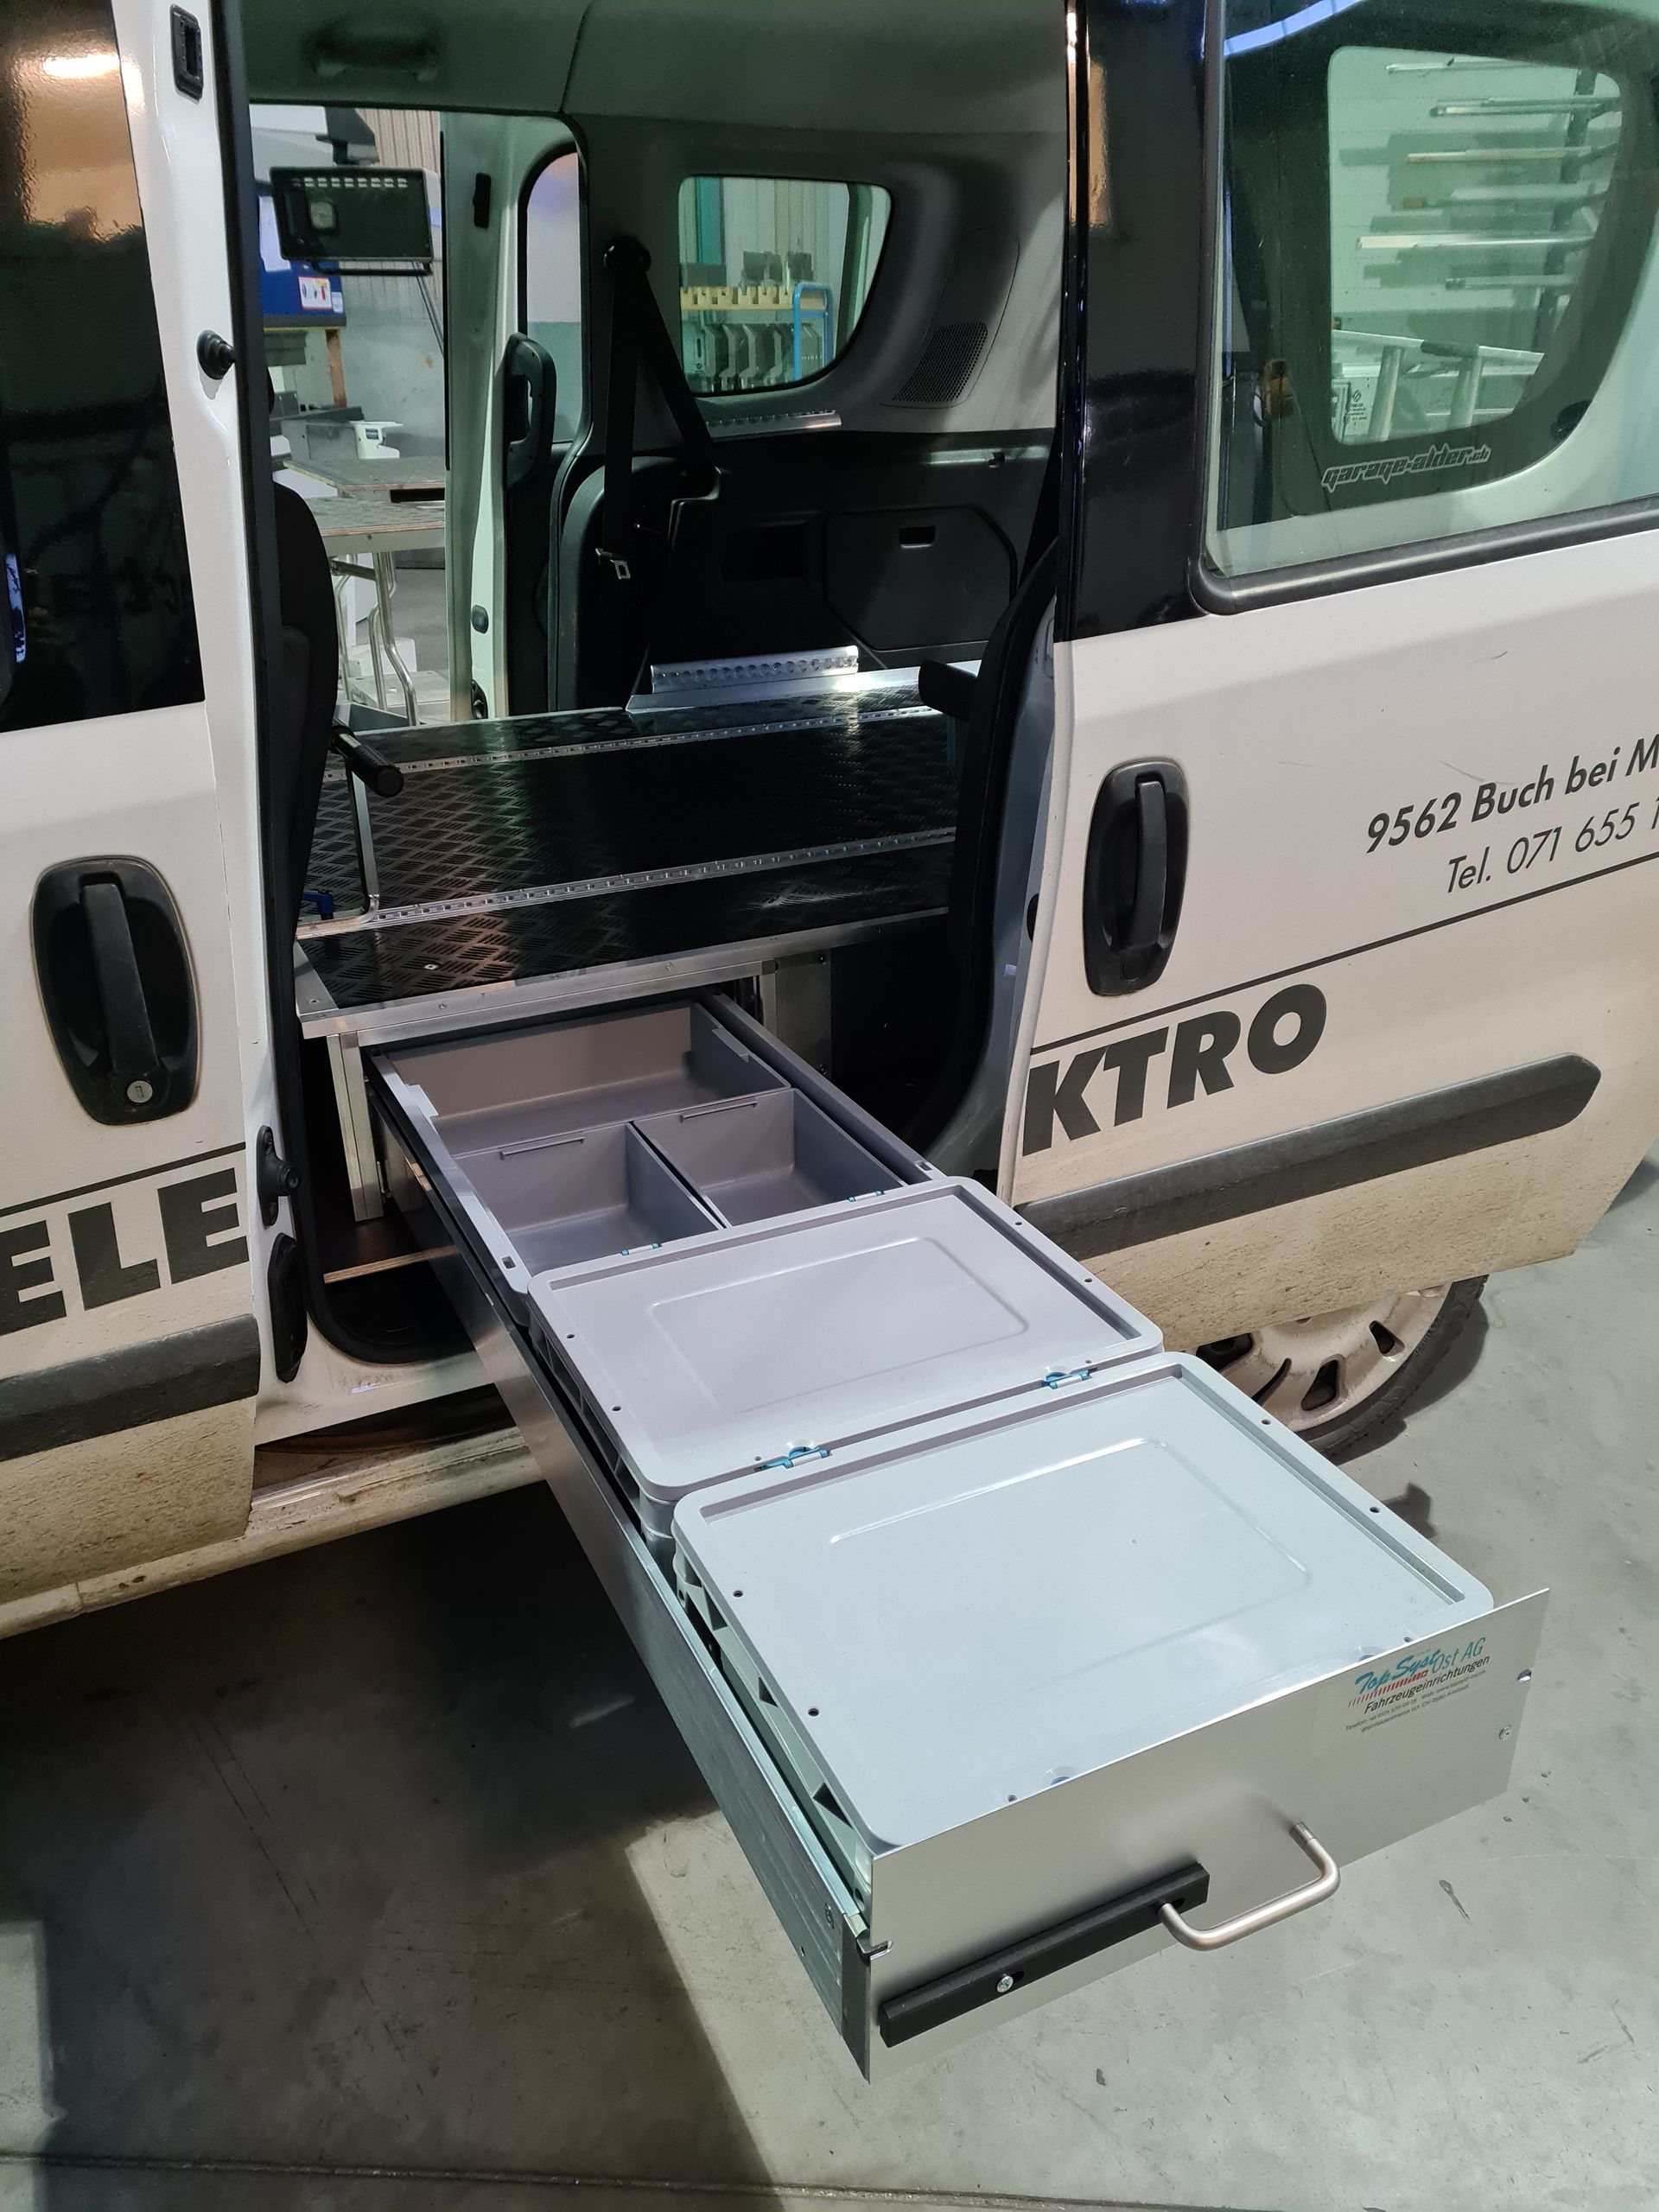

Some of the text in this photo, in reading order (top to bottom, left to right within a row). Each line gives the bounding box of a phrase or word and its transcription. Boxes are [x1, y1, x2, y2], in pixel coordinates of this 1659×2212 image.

[1366, 791, 1462, 854] 9562
[1471, 764, 1555, 823] Buch
[1565, 746, 1621, 794] bei
[1447, 846, 1491, 893] Tel.
[1506, 826, 1562, 874] 071
[1574, 802, 1640, 853] 655
[1022, 983, 1327, 1157] KTRO
[0, 1167, 250, 1337] ELE
[1364, 1656, 1491, 1714] Fahrzeugeinrichtungen
[1432, 1649, 1459, 1674] Ost
[1460, 1637, 1486, 1662] AG
